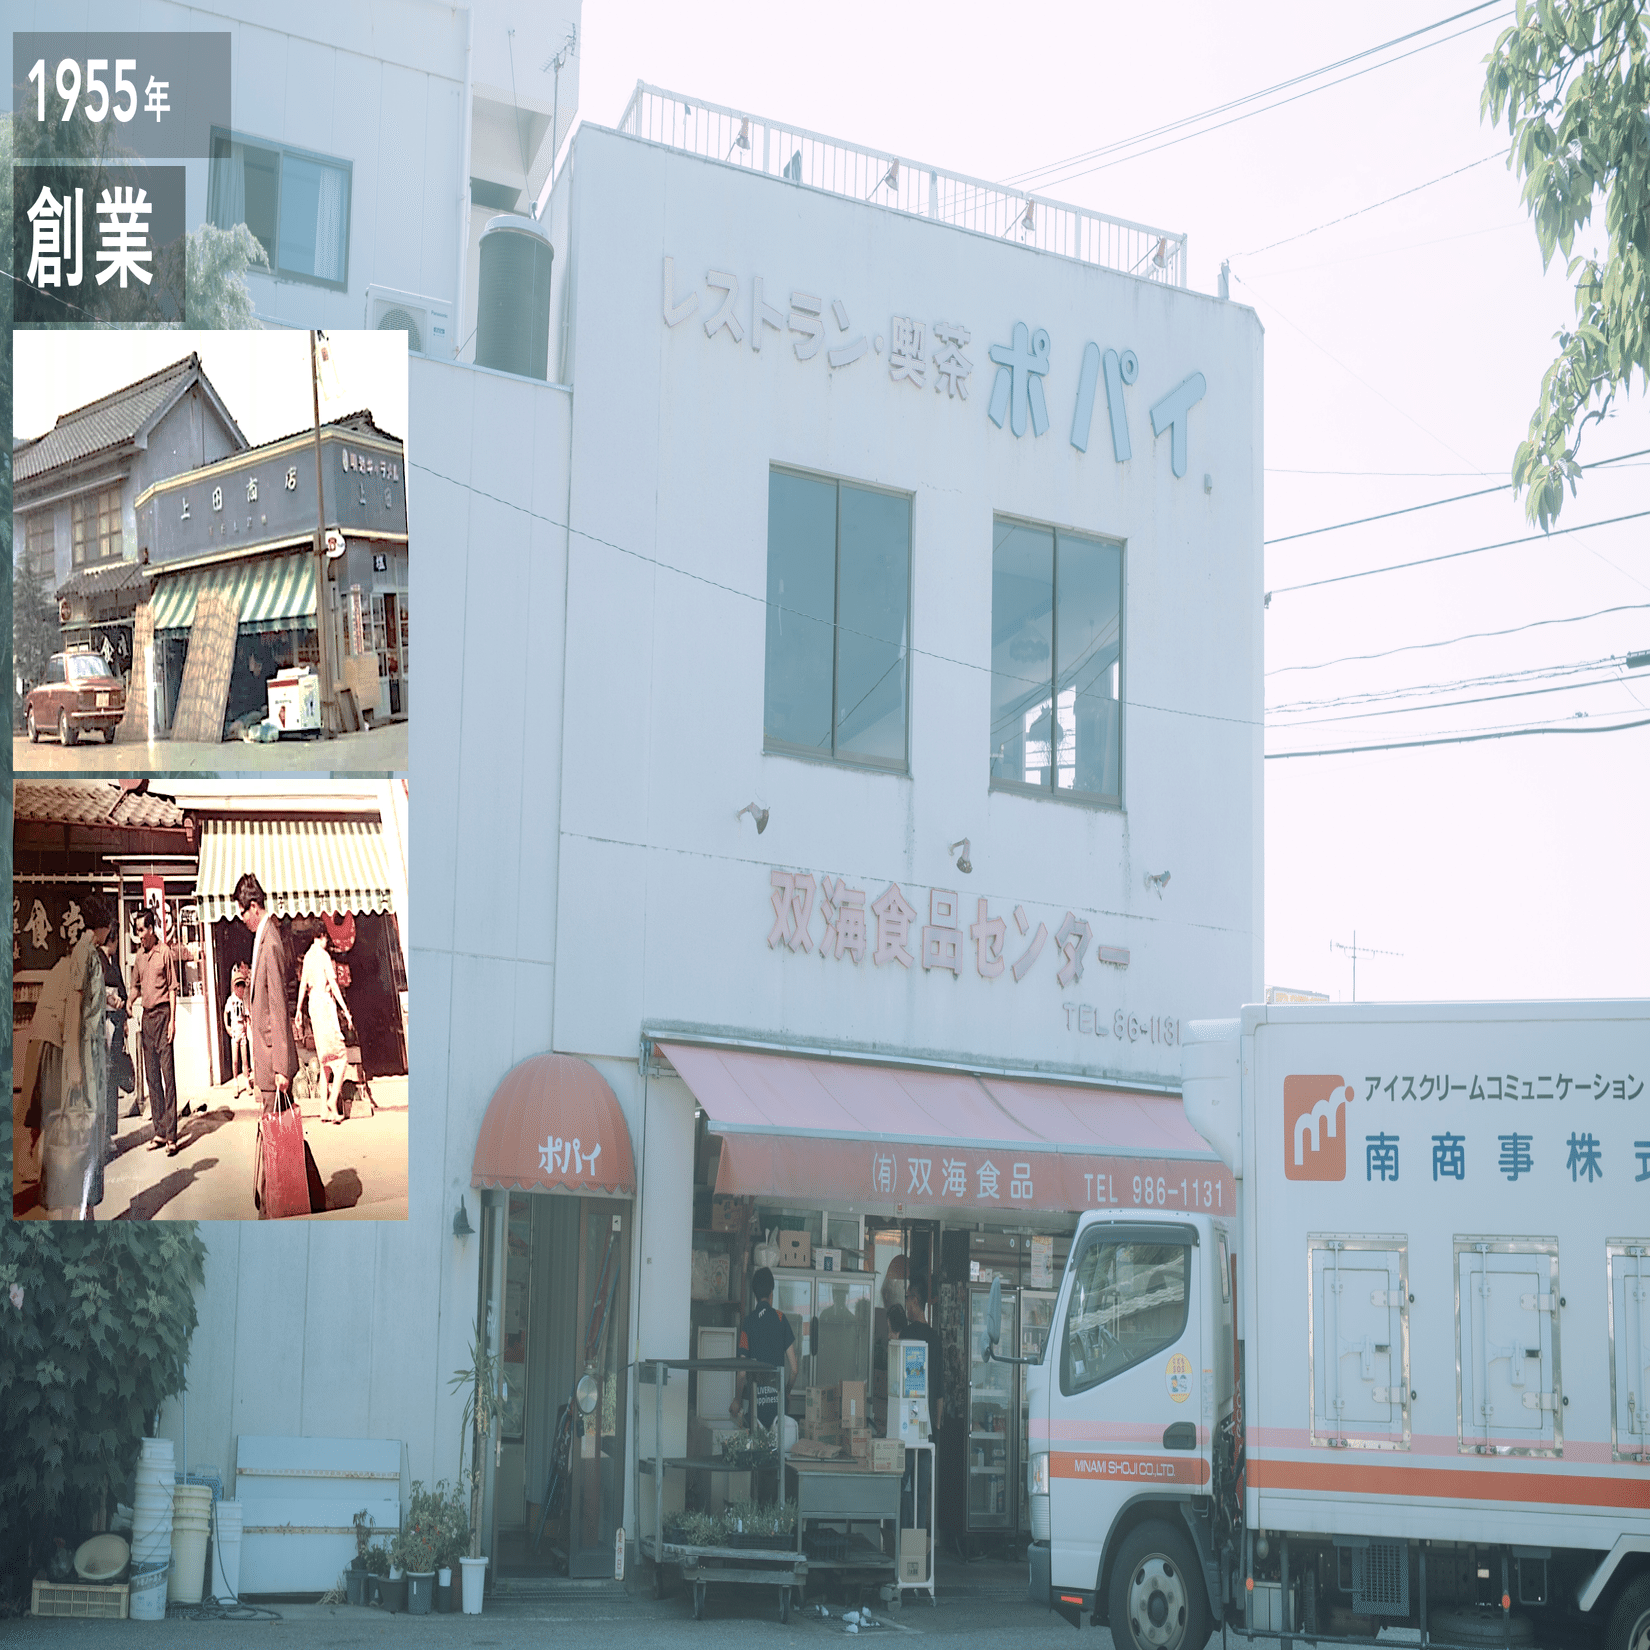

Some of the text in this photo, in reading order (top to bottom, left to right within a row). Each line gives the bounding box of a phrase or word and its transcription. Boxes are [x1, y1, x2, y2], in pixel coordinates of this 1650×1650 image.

[988, 321, 1207, 478] ポパイ
[767, 870, 1130, 988] 双海食品センター
[1364, 1073, 1645, 1101] アイスクリームコミュニケーション
[538, 1135, 601, 1176] ポパイ
[1084, 1173, 1224, 1208] TEL 986-1131
[1074, 1459, 1106, 1473] MINAMI
[1108, 1461, 1138, 1475] SHOJI
